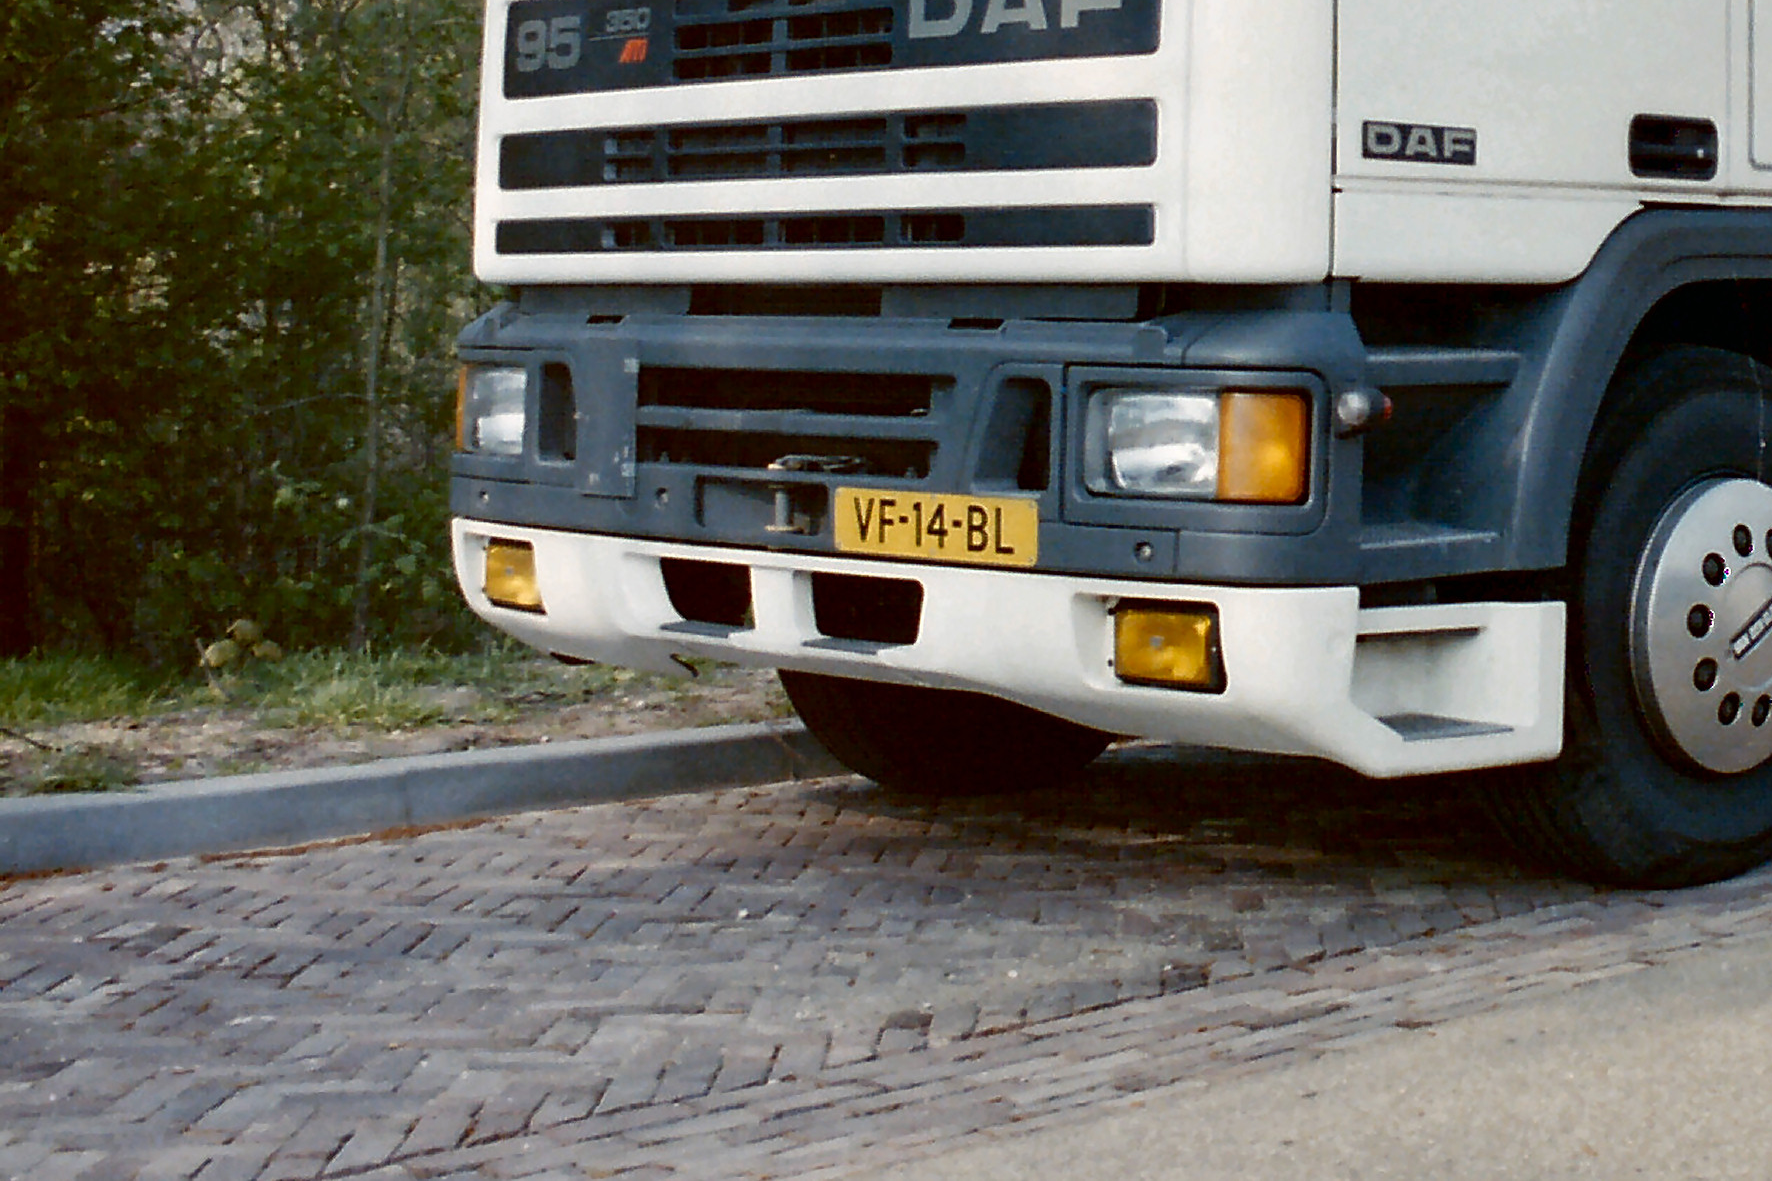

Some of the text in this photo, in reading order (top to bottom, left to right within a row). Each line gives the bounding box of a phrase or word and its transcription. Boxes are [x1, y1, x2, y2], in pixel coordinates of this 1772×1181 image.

[516, 16, 581, 73] 95
[1366, 122, 1476, 159] DAF
[854, 497, 1015, 555] VF-14-BL
